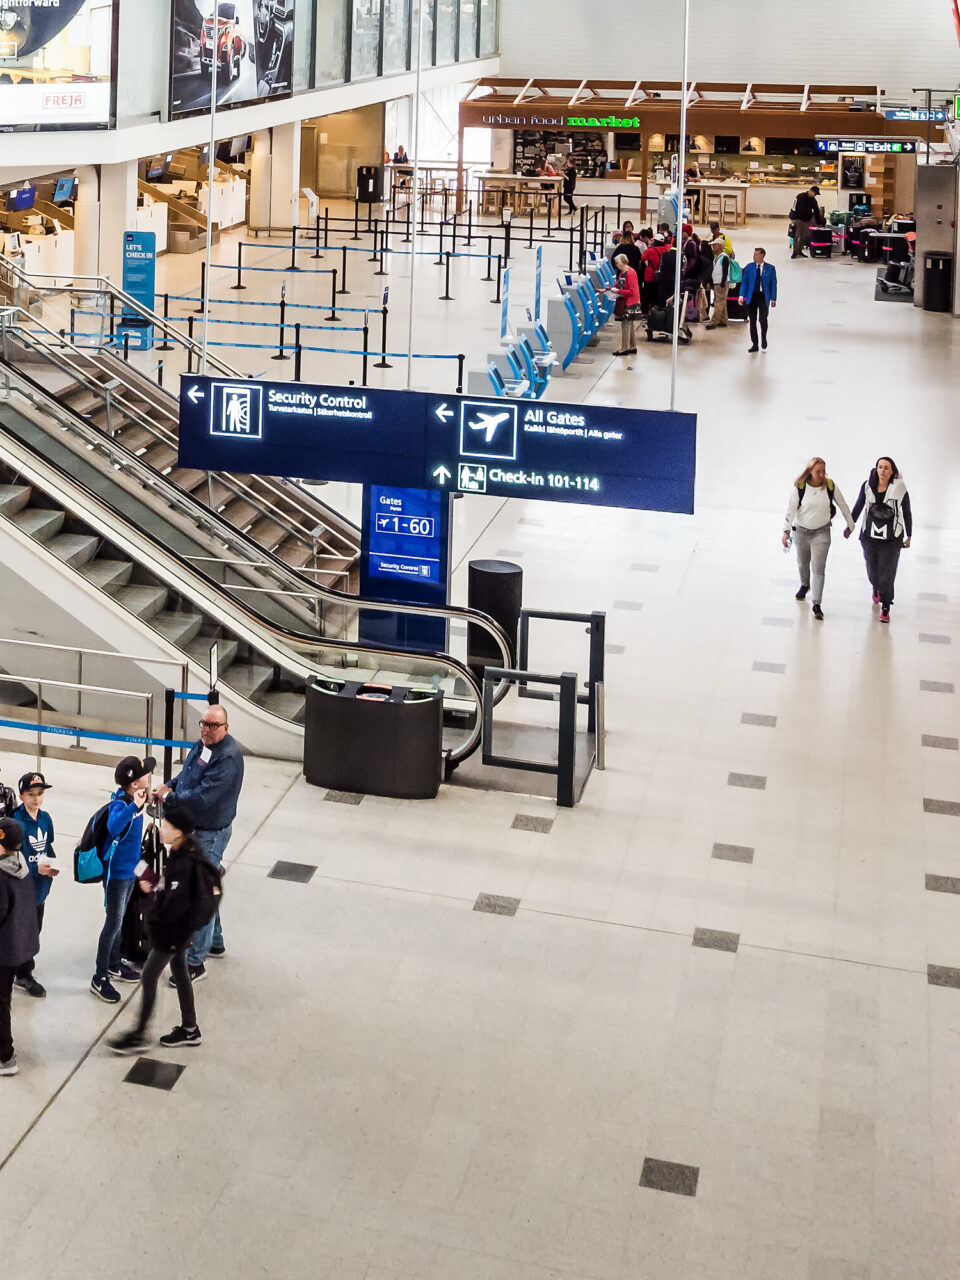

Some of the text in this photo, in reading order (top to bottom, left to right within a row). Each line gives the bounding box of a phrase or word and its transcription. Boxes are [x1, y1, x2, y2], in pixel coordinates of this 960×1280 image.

[45, 95, 82, 107] FREJA
[482, 113, 640, 128] urban food market
[268, 389, 367, 409] Security Control
[524, 409, 585, 426] All Gates
[489, 469, 599, 491] Check-in 101-114
[380, 496, 402, 506] Gates
[380, 562, 400, 570] Security
[46, 726, 74, 735] FINAVIA
[125, 736, 153, 745] FINAVIA
